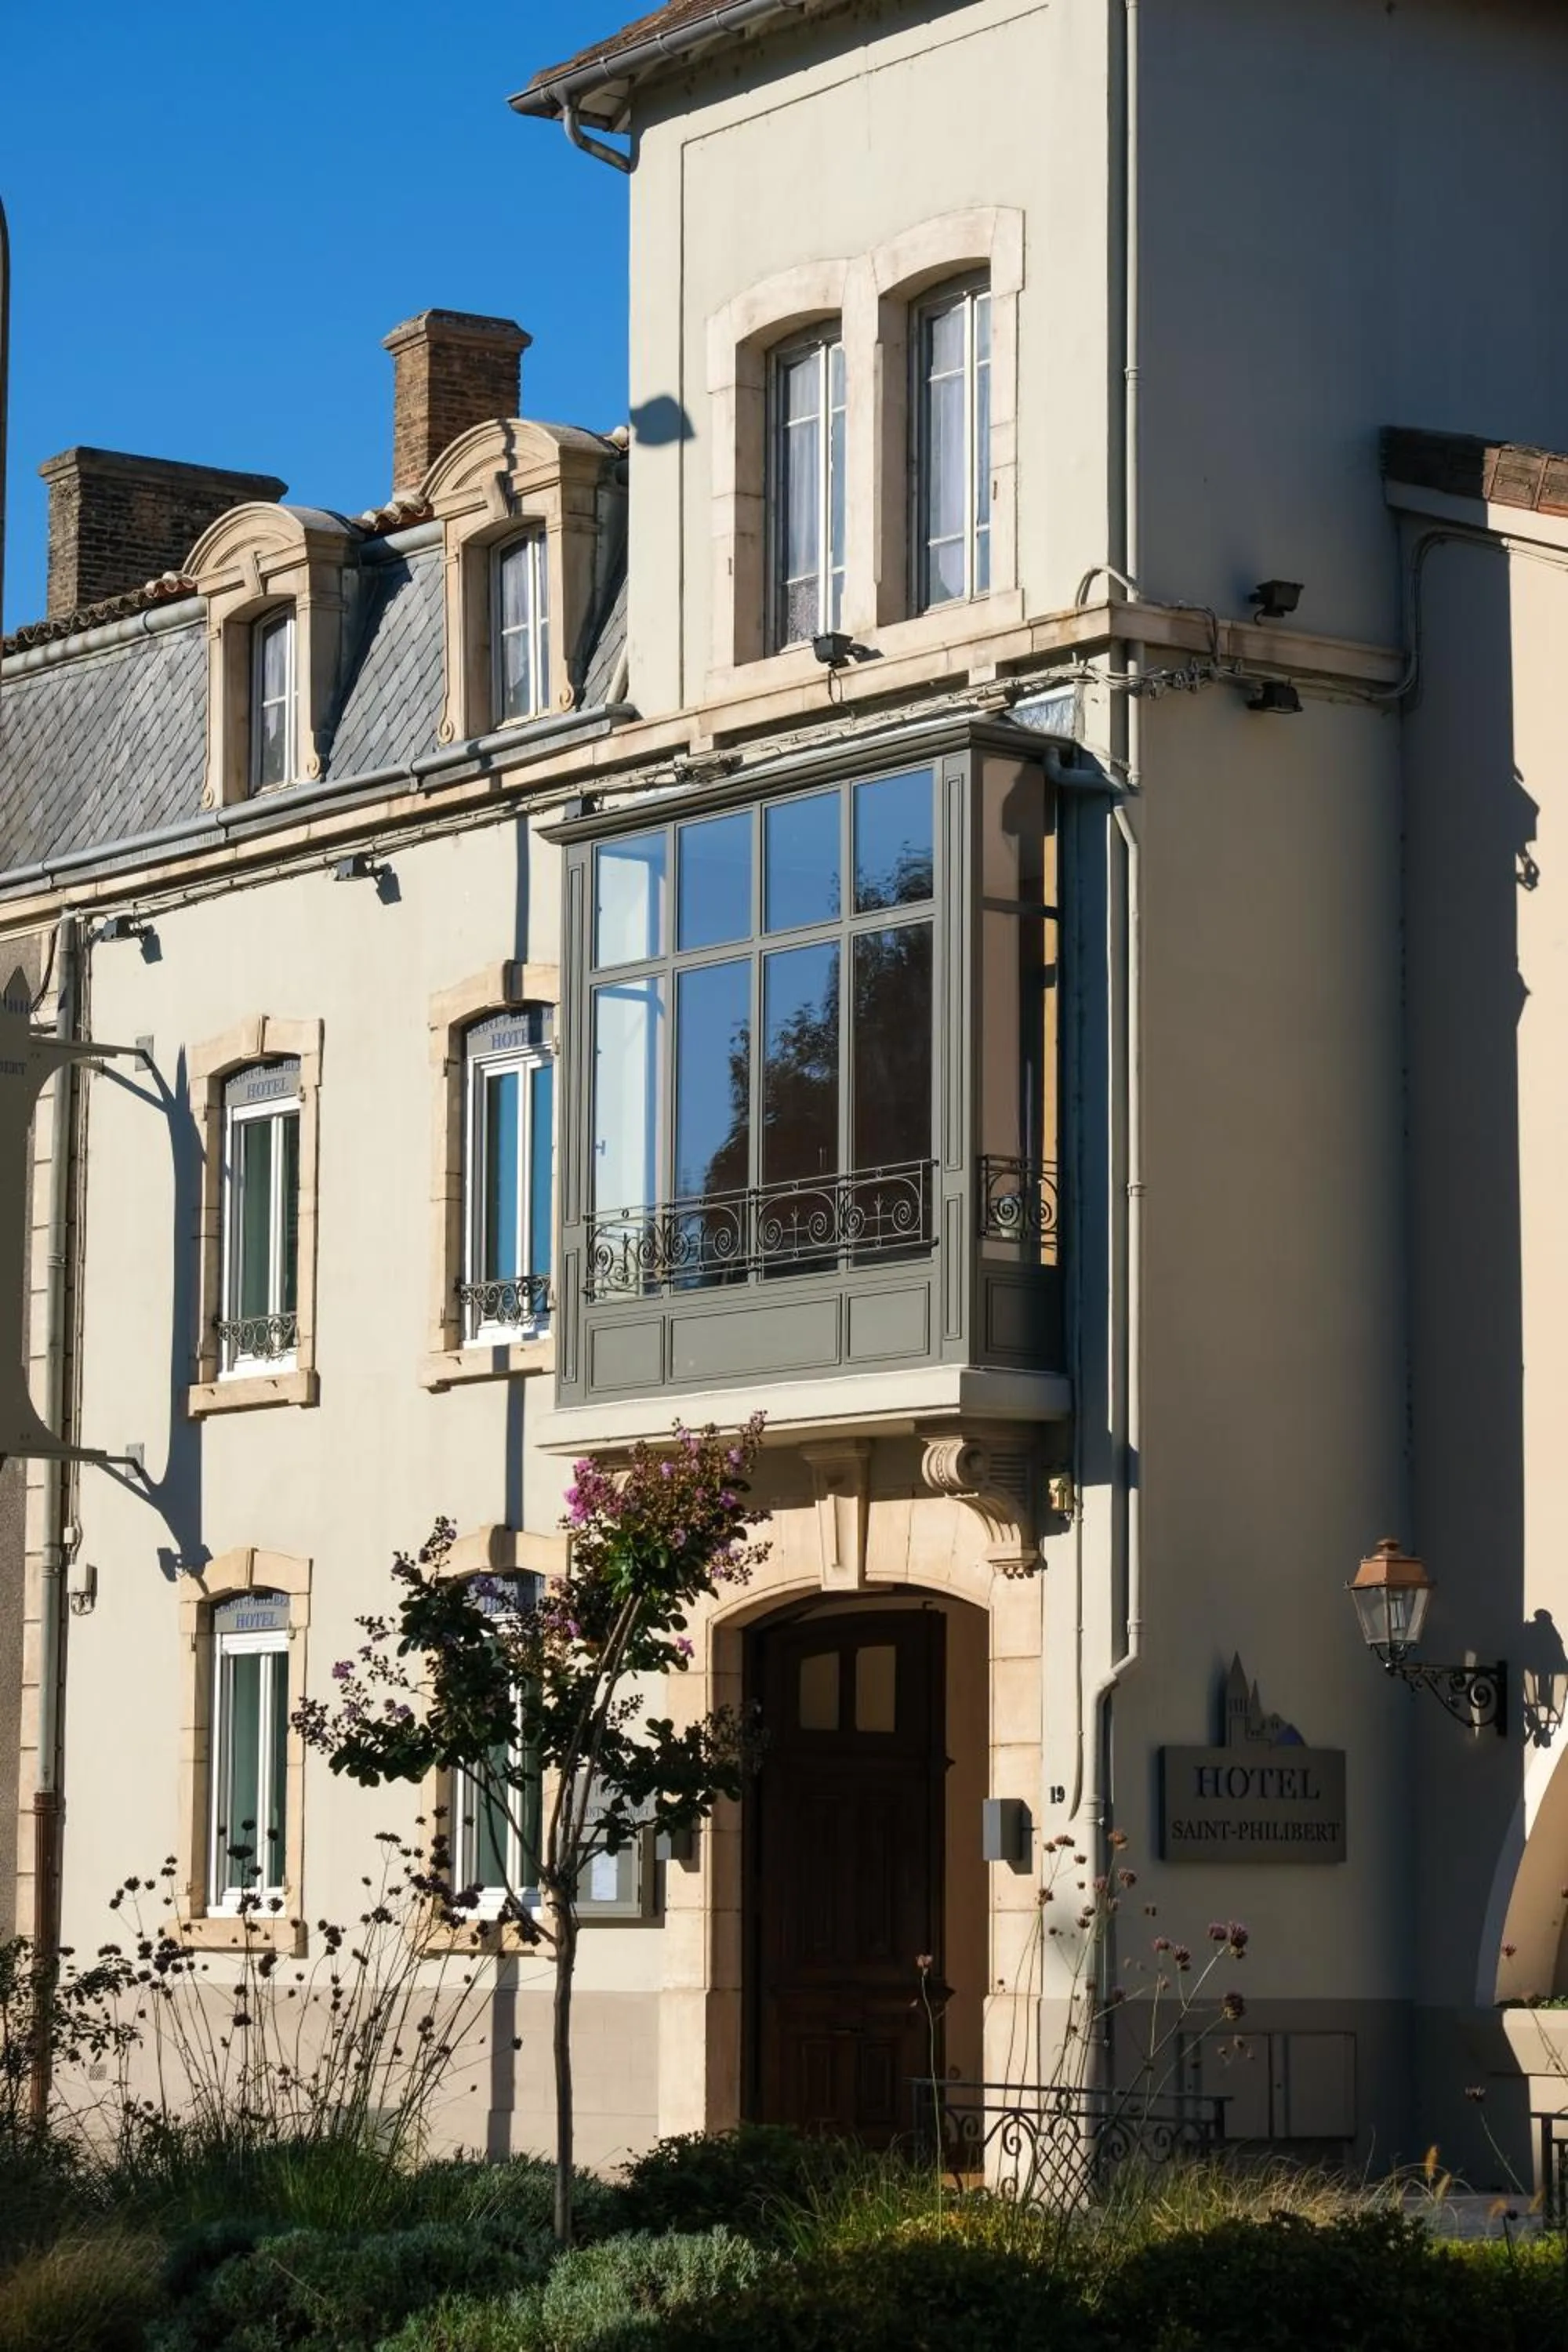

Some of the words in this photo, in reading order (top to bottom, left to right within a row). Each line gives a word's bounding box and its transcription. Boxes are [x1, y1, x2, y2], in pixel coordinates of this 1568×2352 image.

[492, 1028, 532, 1049] HOTE
[247, 1077, 290, 1098] HOTEL
[236, 1611, 276, 1628] HOTEL
[1193, 1766, 1320, 1800] HOTEL
[1050, 1786, 1065, 1803] 19
[1171, 1819, 1341, 1842] SAINT-PHILIBERT
